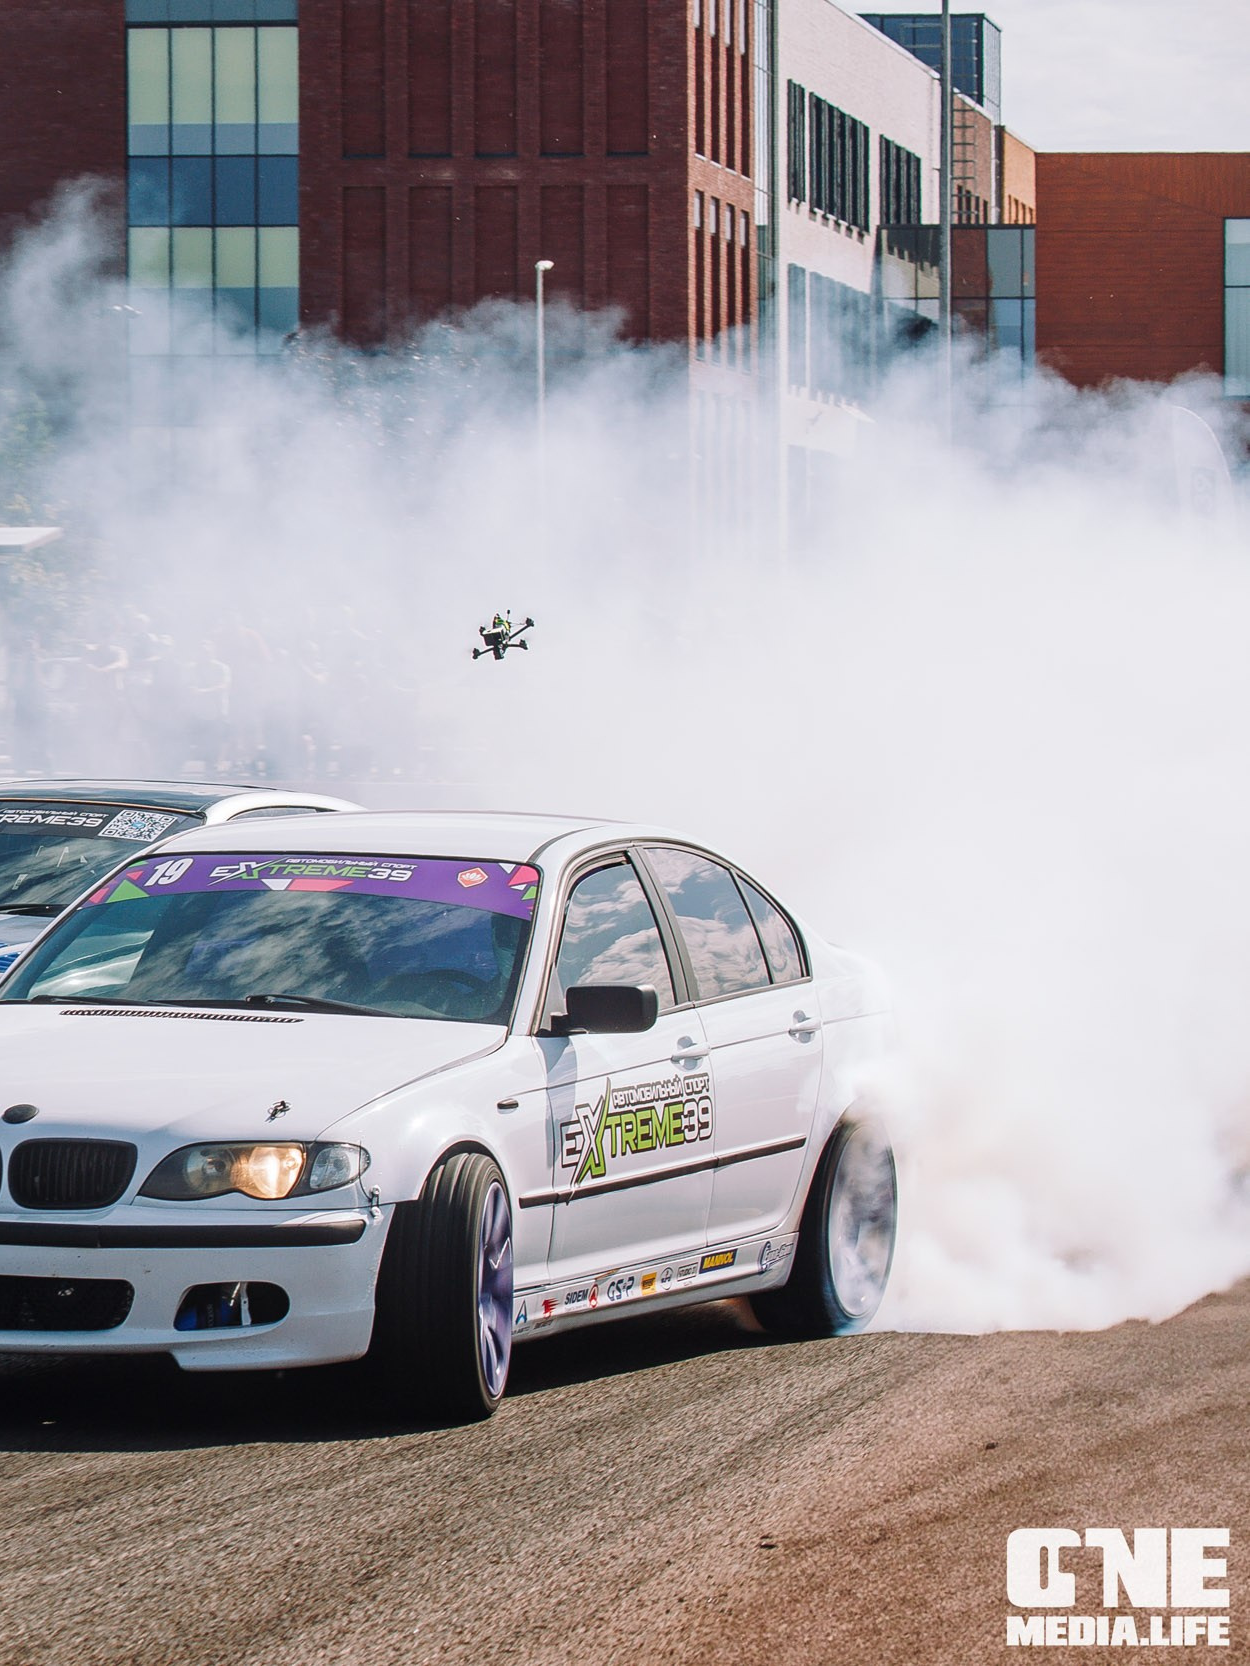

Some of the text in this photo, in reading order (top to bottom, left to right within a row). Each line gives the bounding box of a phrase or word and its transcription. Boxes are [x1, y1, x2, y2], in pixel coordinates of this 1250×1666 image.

[144, 858, 193, 886] 19
[207, 857, 412, 886] EXTREME39
[285, 858, 378, 867] АВТОМОБИЛЬНЫЙ
[612, 1073, 710, 1108] АВТОМОБИЛЬНЫЙ СПОРТ
[560, 1077, 714, 1187] EXTREME39
[702, 1251, 734, 1270] MANNOL
[565, 1289, 589, 1305] SIDEM
